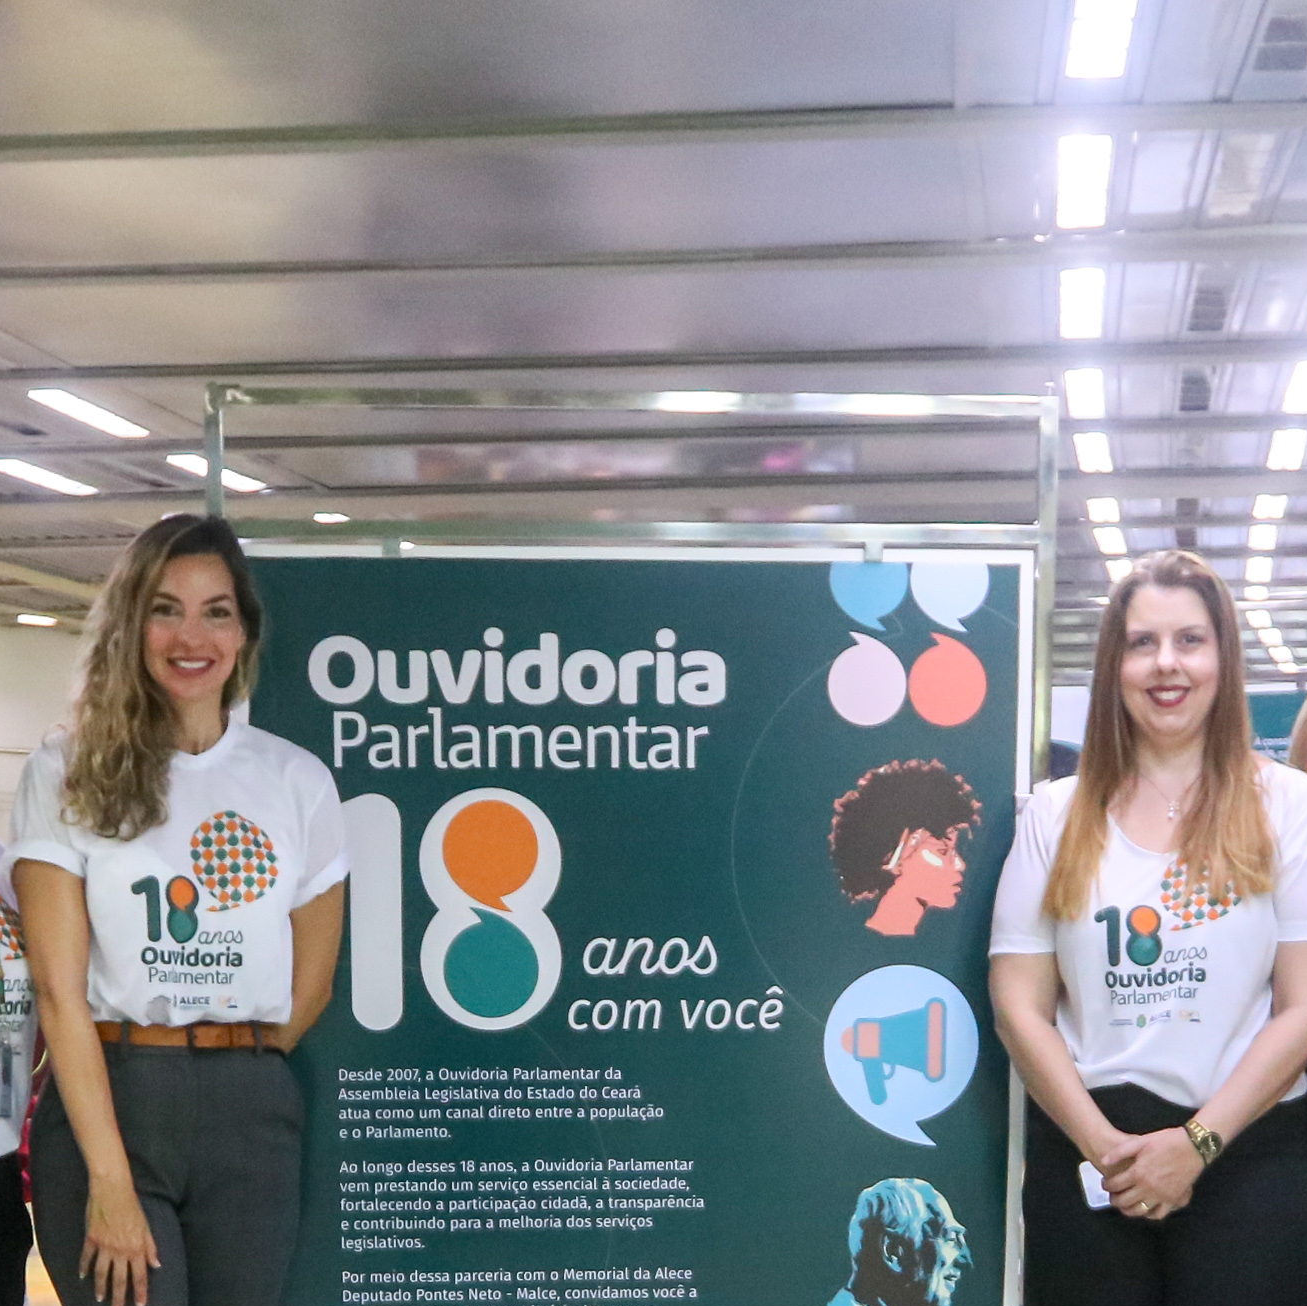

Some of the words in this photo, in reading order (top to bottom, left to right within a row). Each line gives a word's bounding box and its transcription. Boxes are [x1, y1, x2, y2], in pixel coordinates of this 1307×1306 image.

[307, 627, 727, 706] Ouvidoria
[332, 706, 710, 769] Parlamentar
[131, 874, 199, 944] 18
[198, 929, 244, 945] anos
[341, 787, 563, 1032] 18
[1094, 905, 1163, 967] 18
[1164, 946, 1208, 965] anos
[140, 946, 243, 967] Ouvidoria
[582, 933, 719, 977] anos
[1105, 962, 1207, 989] Ouvidoria
[1111, 984, 1199, 1006] Parlamentar
[566, 997, 662, 1032] com
[679, 986, 785, 1032] você
[338, 1068, 383, 1082] Desde
[386, 1068, 421, 1083] 2007,
[425, 1070, 434, 1081] a
[438, 1067, 509, 1081] Ouvidoria
[513, 1067, 601, 1081] Parlamentar
[604, 1066, 623, 1080] da
[338, 1087, 420, 1102] Assembleia
[425, 1086, 500, 1102] Legislativa
[504, 1086, 522, 1100] do
[527, 1086, 575, 1100] Estado
[579, 1085, 598, 1101] do
[602, 1085, 642, 1099] Ceará
[338, 1107, 371, 1121] atua
[375, 1109, 414, 1120] como
[419, 1108, 441, 1119] um
[446, 1105, 485, 1120] canal
[488, 1105, 532, 1120] direto
[535, 1106, 573, 1119] entre
[576, 1107, 586, 1118] a
[590, 1104, 664, 1121] população
[339, 1128, 349, 1141] e
[352, 1128, 362, 1139] o
[366, 1125, 452, 1139] Parlamento.
[339, 1161, 358, 1175] Ao
[362, 1160, 403, 1176] longo
[407, 1160, 456, 1174] desses
[459, 1160, 475, 1173] 18
[479, 1161, 517, 1175] anos,
[521, 1161, 530, 1172] a
[534, 1159, 603, 1172] Ouvidoria
[607, 1159, 694, 1173] Parlamentar
[339, 1182, 370, 1193] vem
[374, 1179, 447, 1195] prestando
[451, 1181, 473, 1192] um
[478, 1178, 528, 1194] serviço
[532, 1177, 598, 1191] essencial
[602, 1177, 611, 1191] à
[614, 1177, 690, 1192] sociedade,
[340, 1197, 432, 1212] fortalecendo
[435, 1200, 445, 1211] a
[449, 1196, 537, 1213] participação
[541, 1196, 591, 1211] cidadã,
[595, 1199, 604, 1209] a
[608, 1195, 705, 1211] transparência
[340, 1220, 350, 1232] e
[353, 1216, 446, 1230] contribuindo
[450, 1218, 482, 1232] para
[485, 1218, 495, 1230] a
[499, 1215, 563, 1230] melhoria
[566, 1215, 592, 1229] dos
[596, 1215, 654, 1231] serviços
[341, 1235, 426, 1251] legislativos.
[342, 1270, 366, 1285] Por
[370, 1270, 406, 1283] meio
[409, 1270, 451, 1284] dessa
[455, 1269, 512, 1285] parceria
[516, 1271, 546, 1283] com
[550, 1271, 559, 1281] o
[563, 1268, 630, 1282] Memorial
[633, 1268, 651, 1282] da
[654, 1267, 693, 1282] Alece
[342, 1288, 412, 1305] Deputado
[416, 1289, 464, 1301] Pontes
[468, 1288, 502, 1301] Neto
[516, 1287, 560, 1302] Malce,
[565, 1287, 649, 1300] convidamos
[652, 1286, 686, 1300] você
[688, 1287, 698, 1299] a
